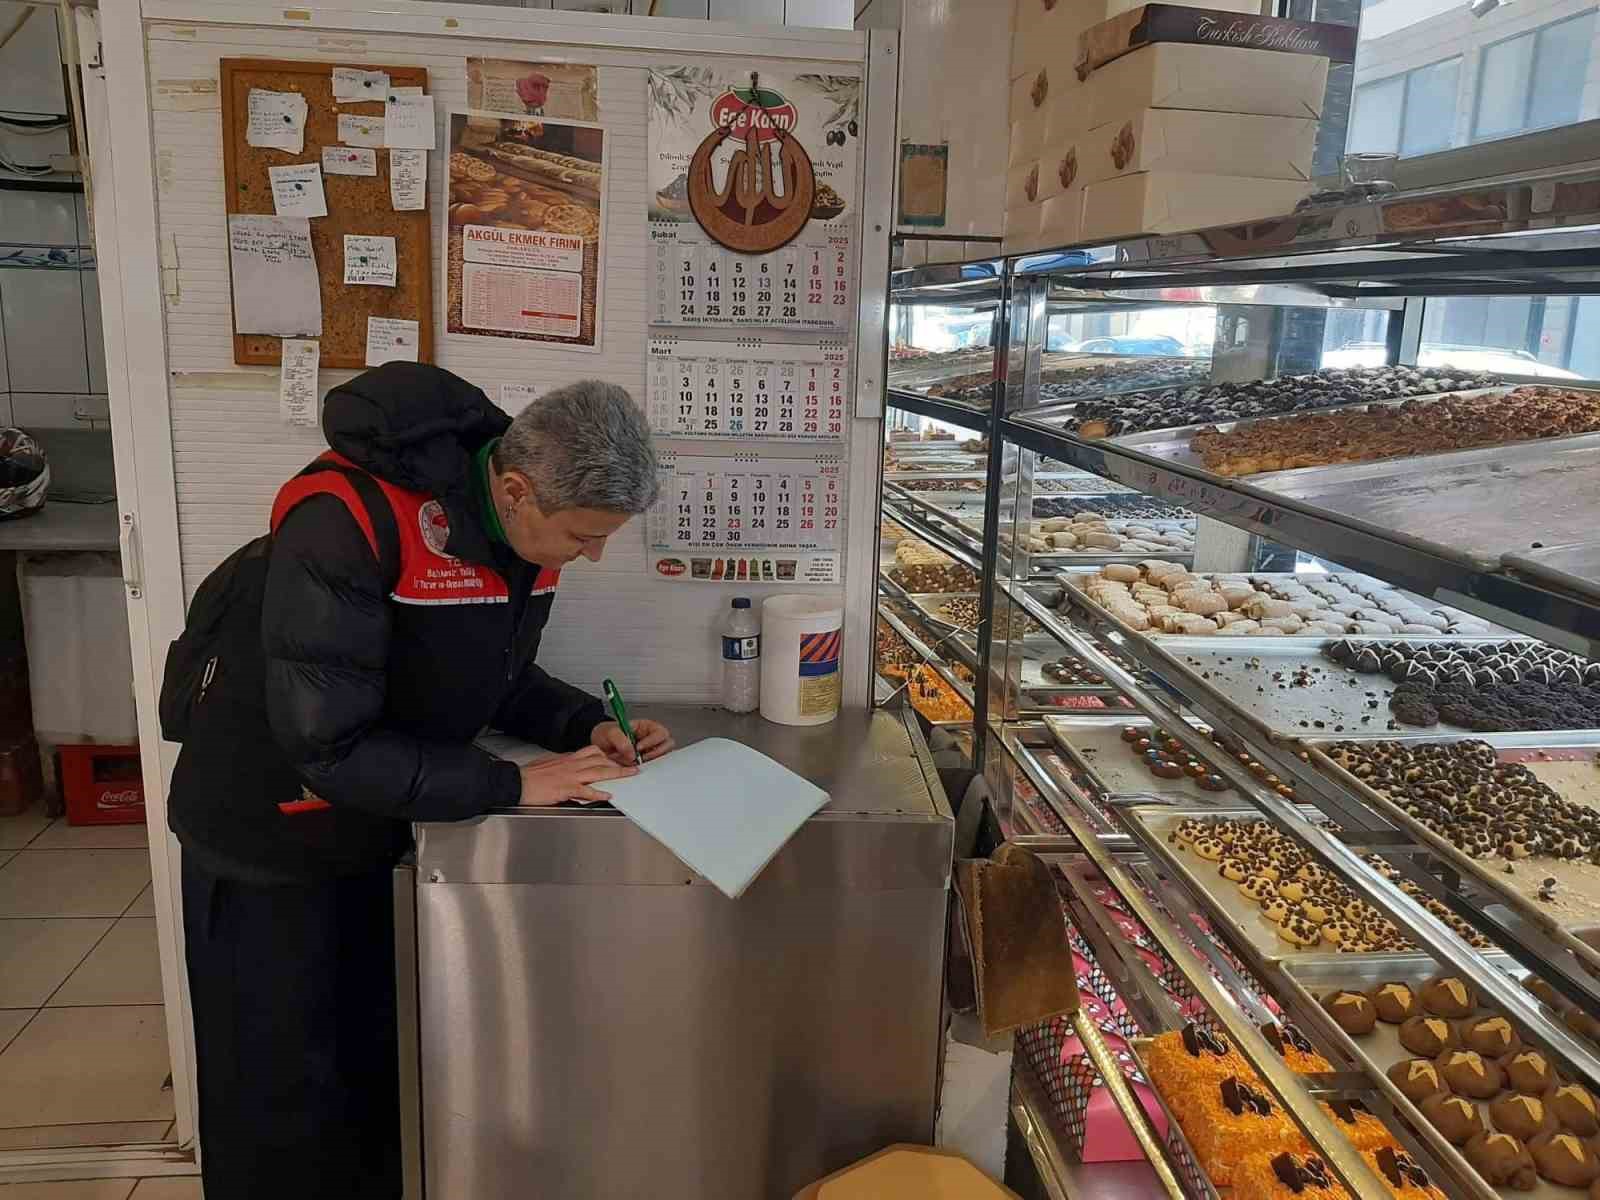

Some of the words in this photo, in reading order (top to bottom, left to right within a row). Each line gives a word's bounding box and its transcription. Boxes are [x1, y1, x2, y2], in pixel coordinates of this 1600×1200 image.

[1196, 16, 1258, 45] Turkish
[1256, 24, 1321, 50] Baklava
[509, 233, 547, 247] EKMEK
[550, 237, 581, 250] FIRINI
[651, 231, 677, 241] Şubat
[828, 236, 849, 244] 2025
[814, 250, 819, 261] 1
[837, 251, 845, 263] 2
[683, 261, 691, 272] 3
[709, 262, 716, 272] 4
[735, 262, 743, 273] 5
[761, 263, 768, 273] 6
[786, 263, 793, 274] 7
[812, 265, 819, 275] 8
[837, 266, 844, 277] 9
[681, 275, 694, 287] 10
[707, 277, 719, 288] 11
[732, 277, 746, 288] 12
[758, 277, 771, 289] 13
[783, 278, 796, 289] 14
[809, 279, 822, 290] 15
[834, 280, 846, 291] 16
[681, 290, 694, 301] 17
[707, 291, 720, 302] 18
[732, 291, 746, 302] 19
[757, 291, 771, 302] 20
[783, 292, 796, 303] 21
[808, 293, 822, 304] 22
[833, 294, 846, 305] 23
[681, 304, 695, 315] 24
[706, 305, 720, 316] 25
[732, 305, 746, 316] 26
[757, 305, 771, 317] 27
[783, 306, 796, 317] 28
[651, 347, 672, 356] Mart
[824, 353, 845, 361] 2025
[810, 368, 815, 378] 1
[833, 368, 840, 378] 2
[682, 377, 689, 387] 3
[708, 378, 715, 388] 4
[733, 379, 740, 389] 5
[758, 380, 765, 390] 6
[783, 380, 791, 391] 7
[808, 381, 815, 391] 8
[832, 382, 840, 392] 9
[680, 391, 692, 401] 10
[706, 392, 717, 402] 11
[730, 393, 743, 403] 12
[755, 394, 768, 404] 13
[781, 395, 793, 405] 14
[805, 395, 818, 405] 15
[830, 396, 842, 406] 16
[679, 405, 692, 415] 17
[705, 406, 718, 416] 18
[730, 406, 743, 417] 19
[754, 407, 768, 417] 20
[780, 408, 792, 418] 21
[804, 408, 818, 419] 22
[828, 409, 841, 419] 23
[704, 419, 718, 430] 25
[729, 420, 743, 432] 26
[754, 420, 768, 431] 27
[779, 421, 793, 432] 28
[804, 422, 817, 432] 29
[828, 422, 841, 433] 30
[819, 466, 840, 474] 2025
[708, 478, 713, 489] 1
[731, 479, 738, 489] 2
[756, 479, 763, 489] 3
[780, 480, 787, 489] 4
[805, 480, 811, 490] 5
[828, 480, 835, 490] 6
[681, 491, 688, 501] 7
[706, 491, 713, 501] 8
[730, 492, 738, 502] 9
[753, 492, 766, 502] 10
[778, 493, 789, 503] 11
[802, 493, 814, 503] 12
[825, 493, 838, 503] 13
[678, 504, 691, 514] 14
[703, 505, 716, 515] 15
[728, 505, 741, 515] 16
[753, 506, 765, 515] 17
[777, 506, 790, 516] 18
[801, 506, 814, 516] 19
[824, 506, 838, 517] 20
[678, 517, 690, 527] 21
[702, 518, 716, 528] 22
[727, 518, 741, 529] 23
[752, 518, 765, 528] 24
[776, 519, 789, 529] 25
[800, 519, 814, 529] 26
[824, 519, 837, 529] 27
[677, 530, 691, 540] 28
[702, 531, 716, 540] 29
[727, 531, 740, 541] 30
